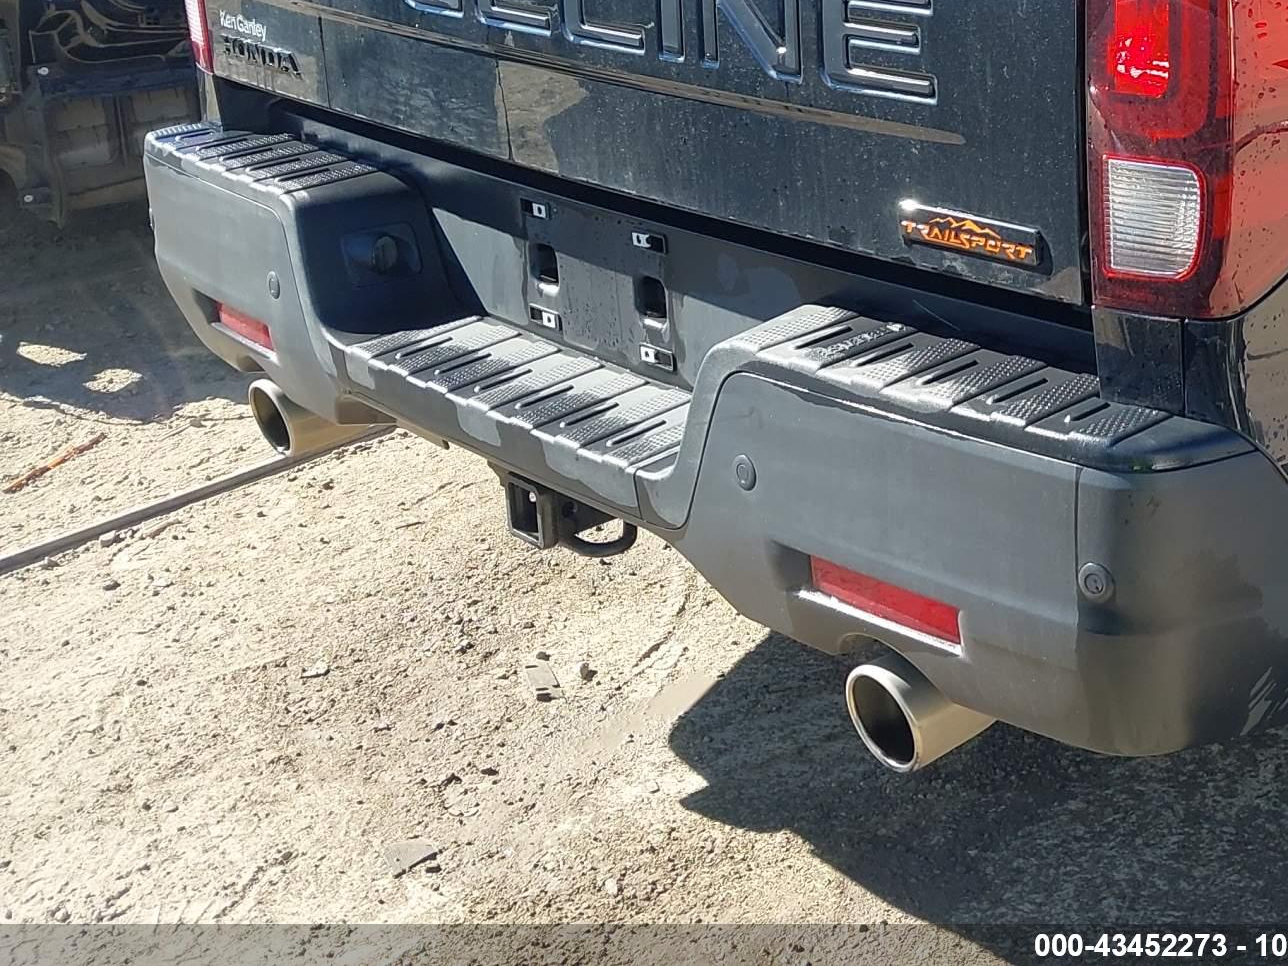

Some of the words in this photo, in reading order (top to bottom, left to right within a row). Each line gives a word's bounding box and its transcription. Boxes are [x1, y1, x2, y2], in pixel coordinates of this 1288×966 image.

[220, 10, 237, 30] Ken
[223, 35, 303, 77] HONDA
[901, 220, 1033, 260] TRAILSPORT
